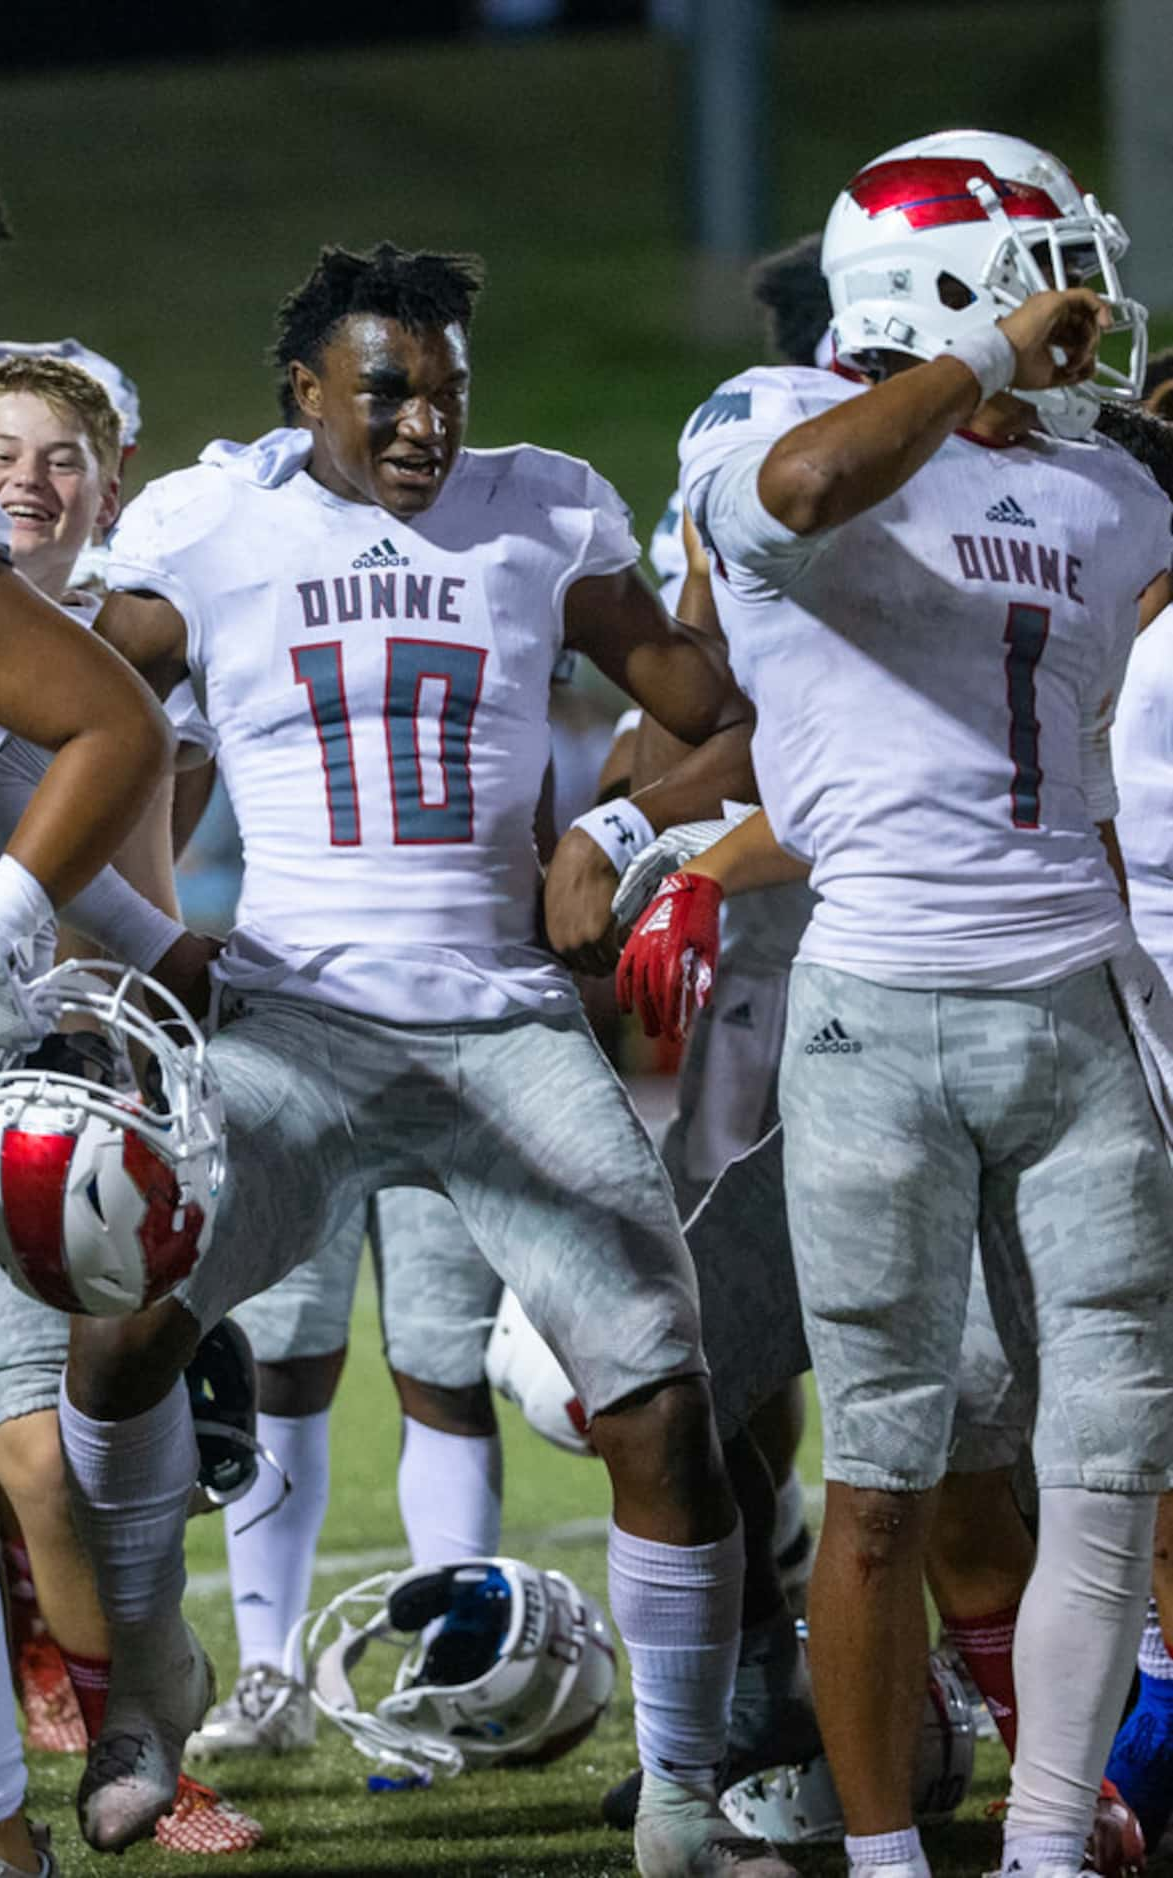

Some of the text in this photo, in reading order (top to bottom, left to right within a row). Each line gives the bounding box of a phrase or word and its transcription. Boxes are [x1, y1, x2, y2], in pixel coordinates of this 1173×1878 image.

[351, 555, 411, 570] adidas
[951, 533, 1085, 605] DUNNE
[296, 572, 466, 628] DUNNE
[289, 636, 489, 846] 10
[1002, 602, 1051, 830] 1
[804, 1041, 862, 1055] adidas
